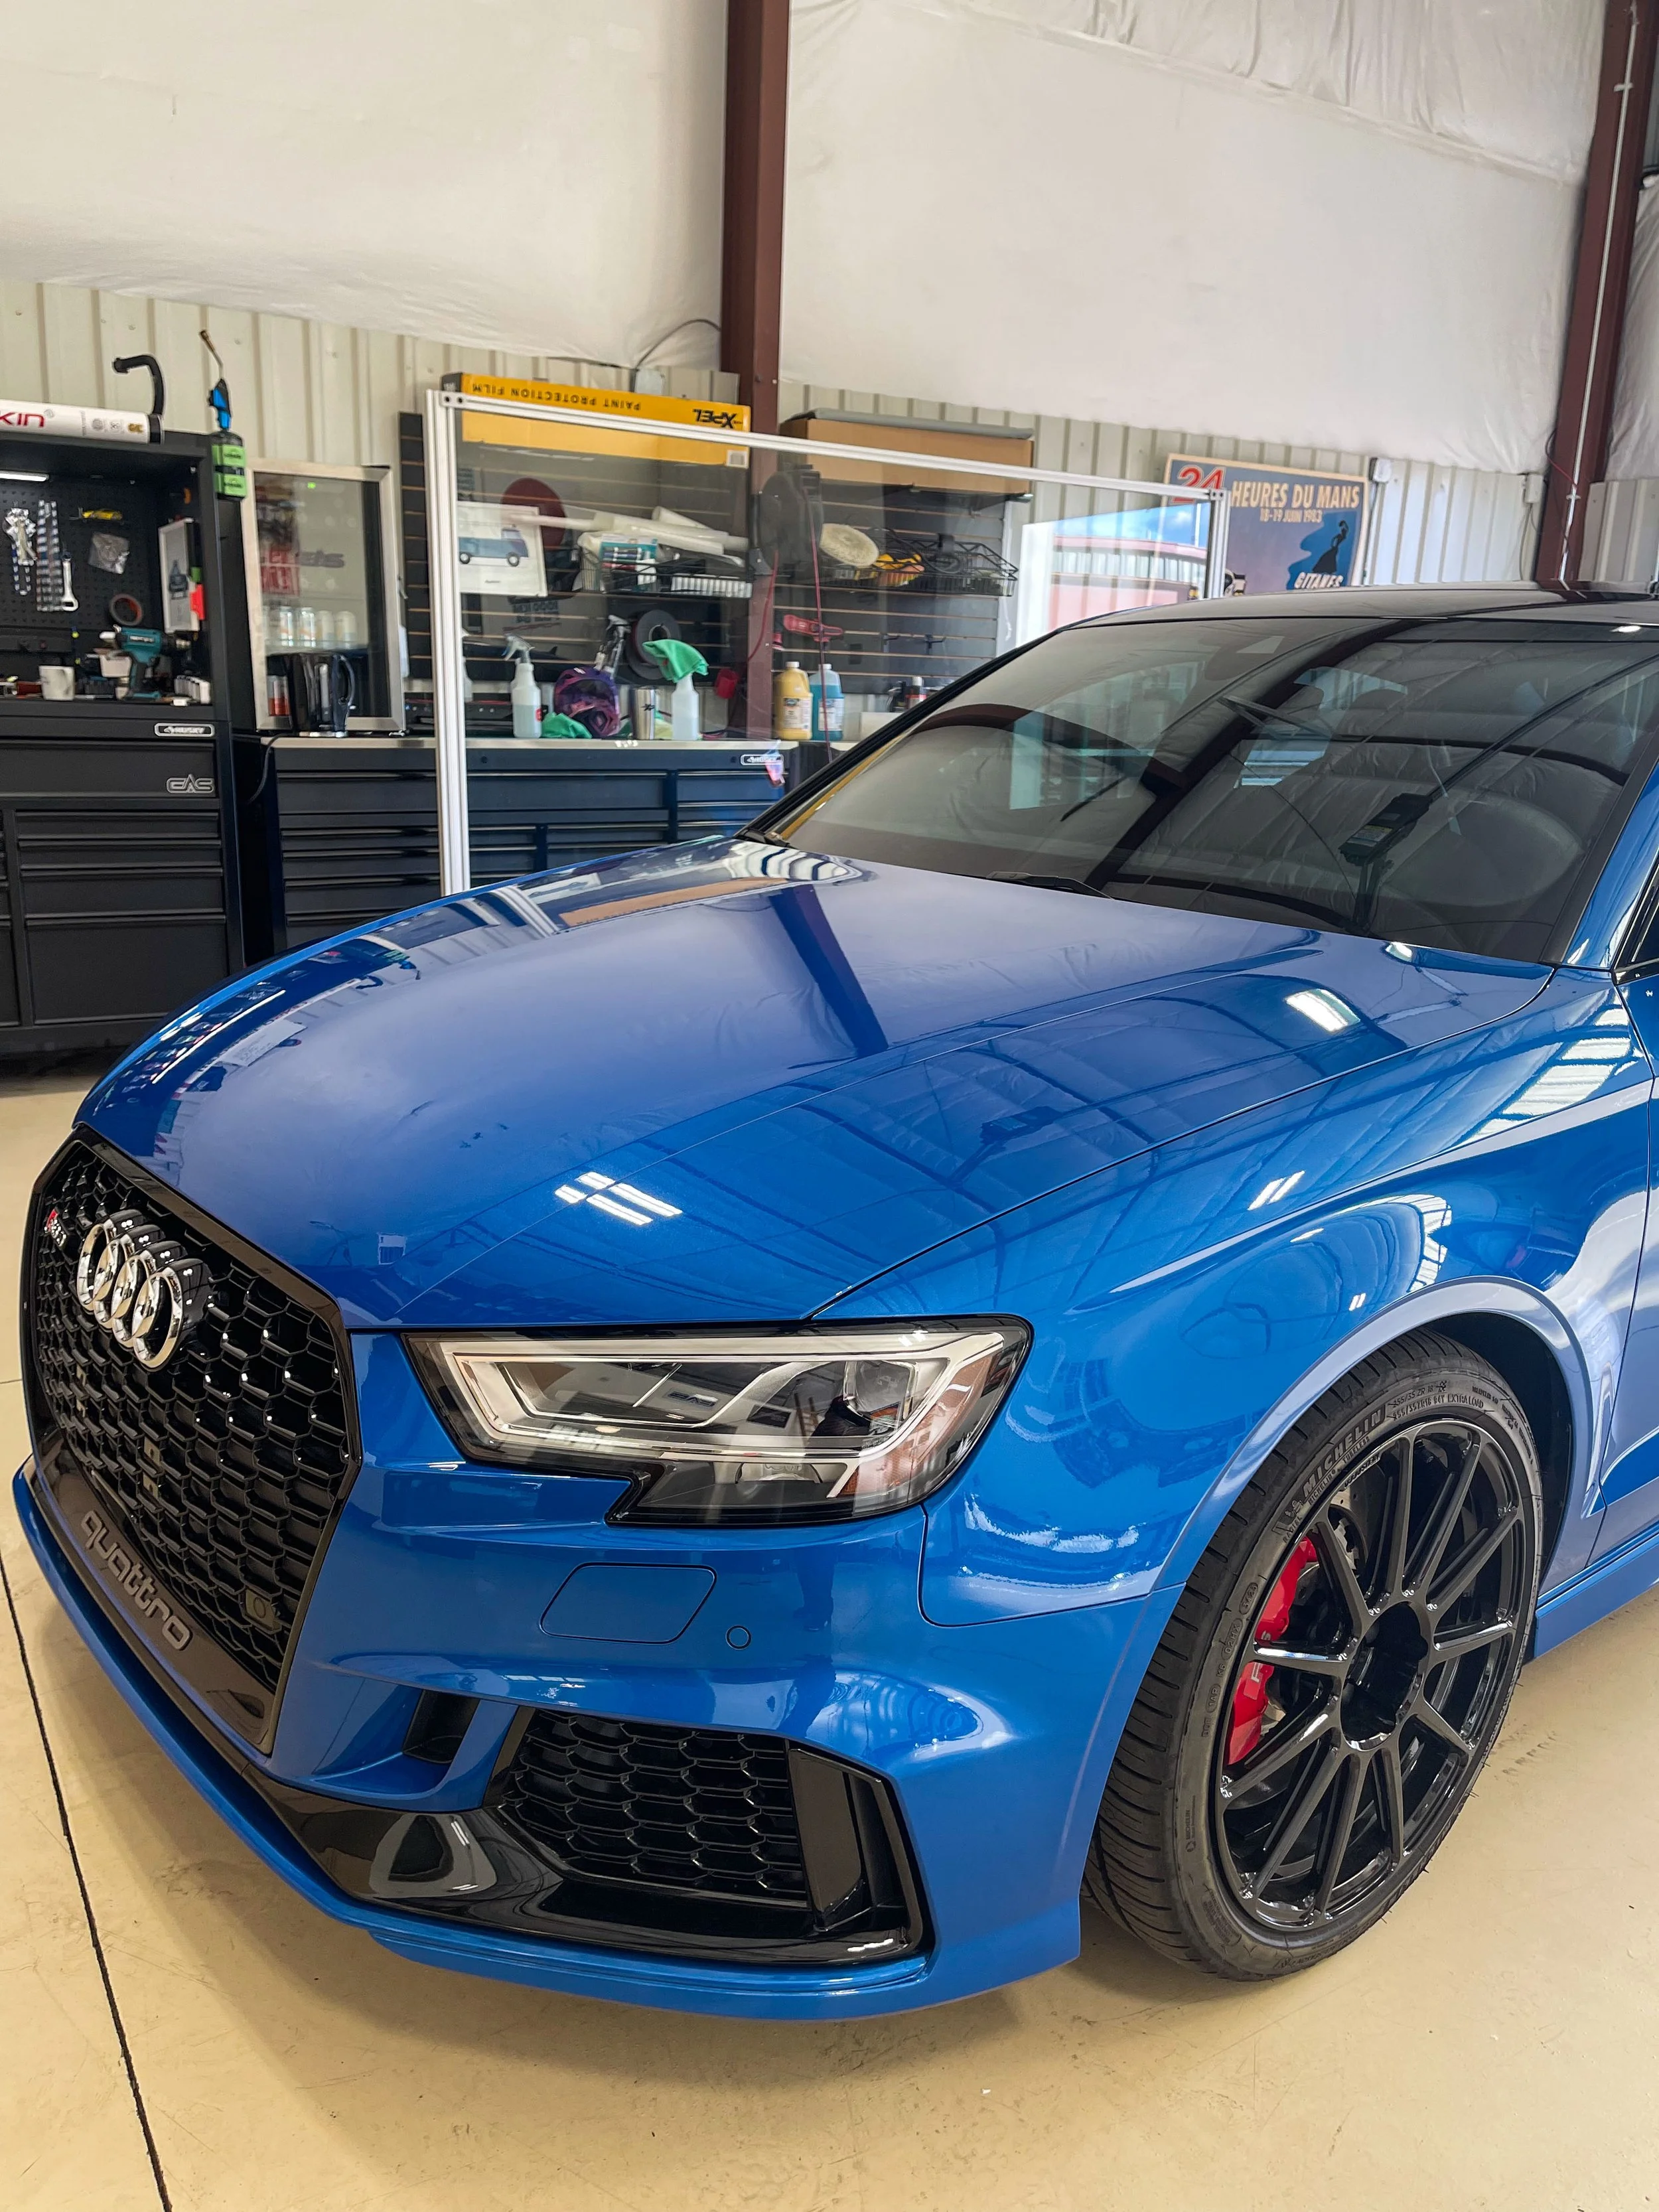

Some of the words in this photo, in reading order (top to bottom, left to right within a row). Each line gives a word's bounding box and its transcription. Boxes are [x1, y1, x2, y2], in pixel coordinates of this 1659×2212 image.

[472, 383, 505, 396] FILM
[510, 387, 597, 406] PROTECTION
[603, 401, 641, 411] PAINT
[692, 408, 737, 429] XPEL
[1230, 480, 1289, 508] HEURES
[1291, 484, 1315, 508] DU
[1317, 484, 1360, 509] MANS
[1260, 508, 1283, 523] 18-19
[1282, 509, 1303, 523] JUIN
[1303, 509, 1323, 524] 1983
[1468, 1396, 1484, 1409] LOAD
[1302, 1408, 1382, 1498] MICHELIN
[81, 1510, 190, 1651] quattro
